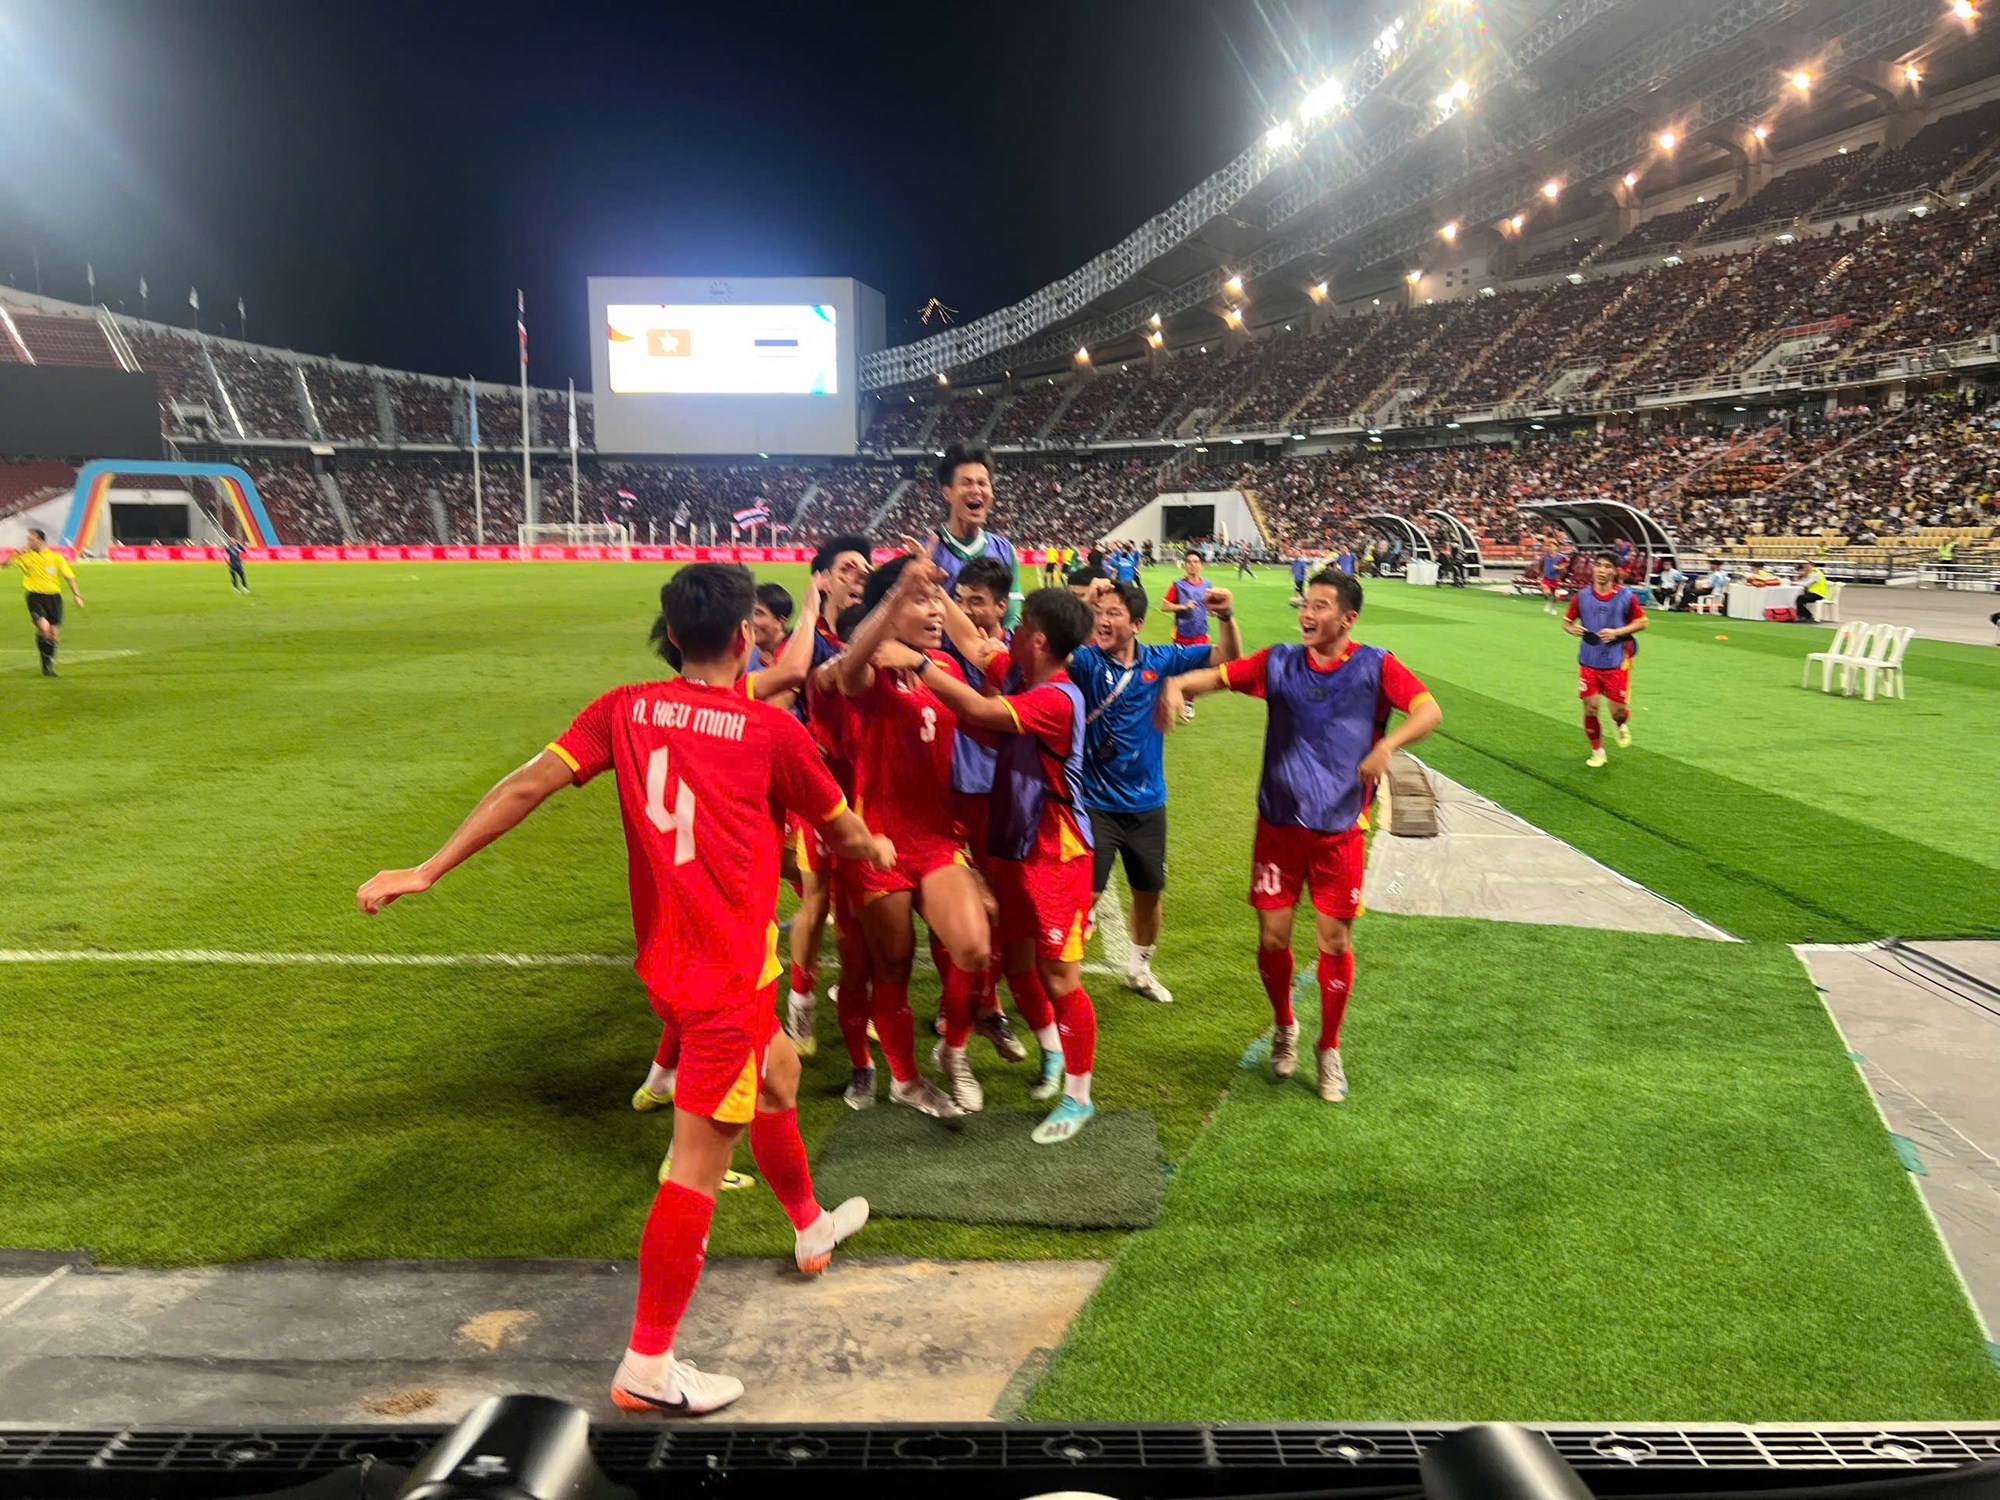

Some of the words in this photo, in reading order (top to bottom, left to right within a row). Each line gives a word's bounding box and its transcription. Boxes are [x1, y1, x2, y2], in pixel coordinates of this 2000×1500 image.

[692, 707, 747, 742] MINH
[919, 705, 937, 743] 3
[645, 745, 696, 867] 4
